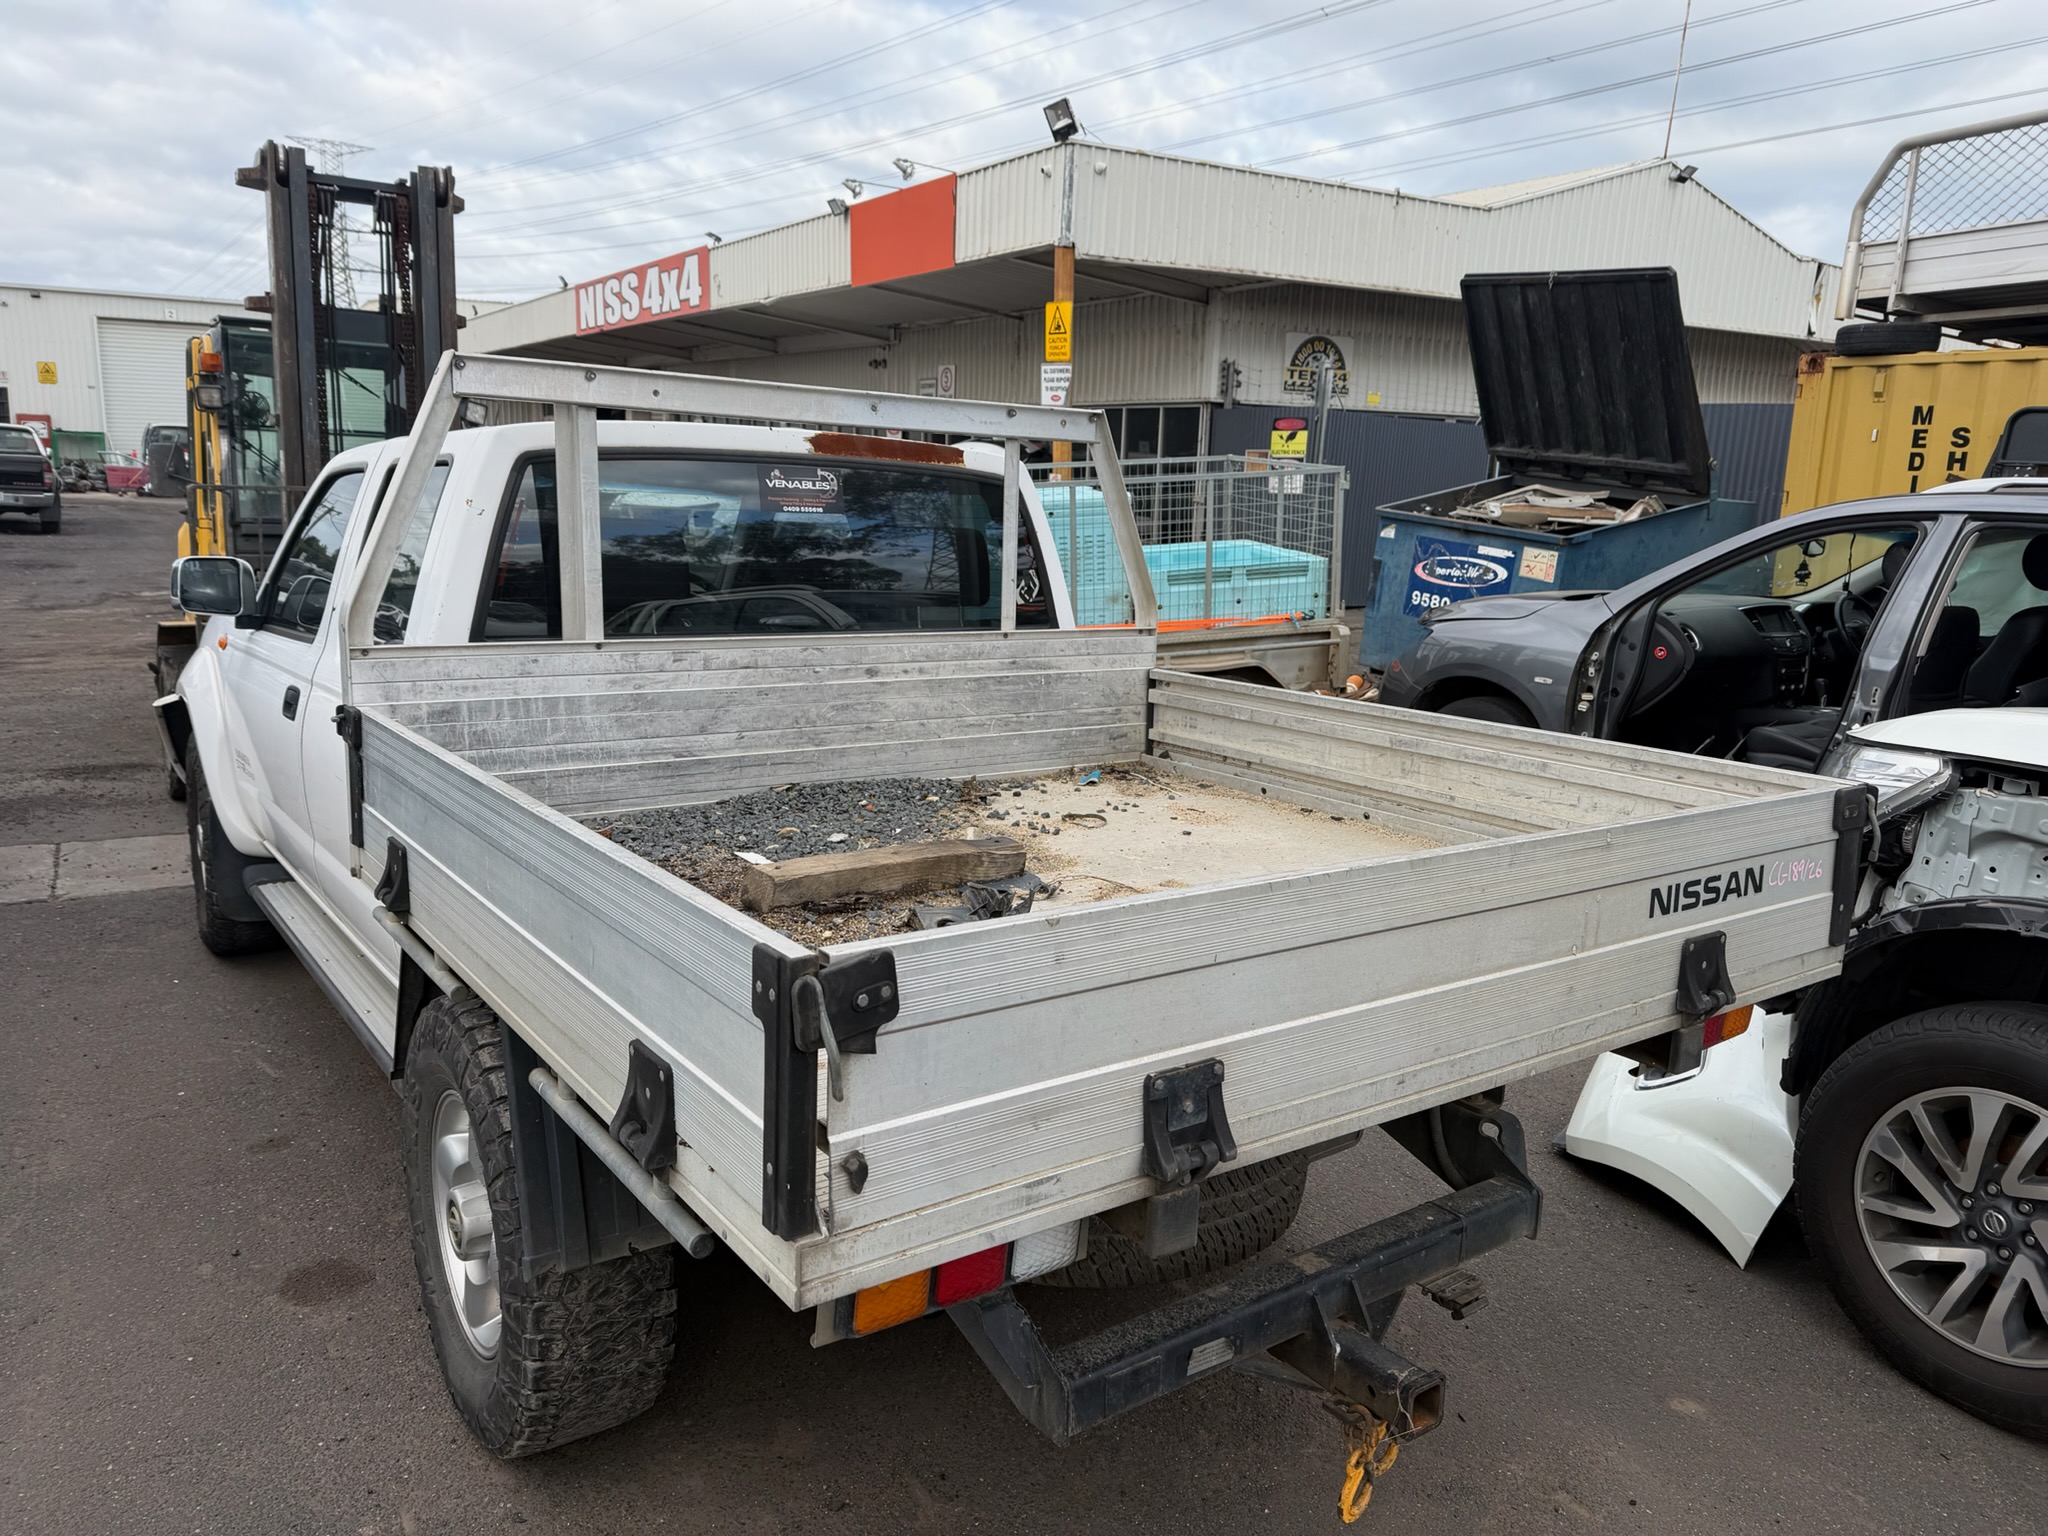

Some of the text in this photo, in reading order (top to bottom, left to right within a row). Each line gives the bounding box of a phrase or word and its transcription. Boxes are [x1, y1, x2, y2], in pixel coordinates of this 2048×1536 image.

[578, 253, 703, 330] NISS 4x4
[168, 310, 174, 318] 2
[1295, 343, 1313, 366] 1800
[1313, 340, 1325, 351] 00
[765, 478, 831, 490] VENABLES
[1649, 865, 1765, 919] NISSAN
